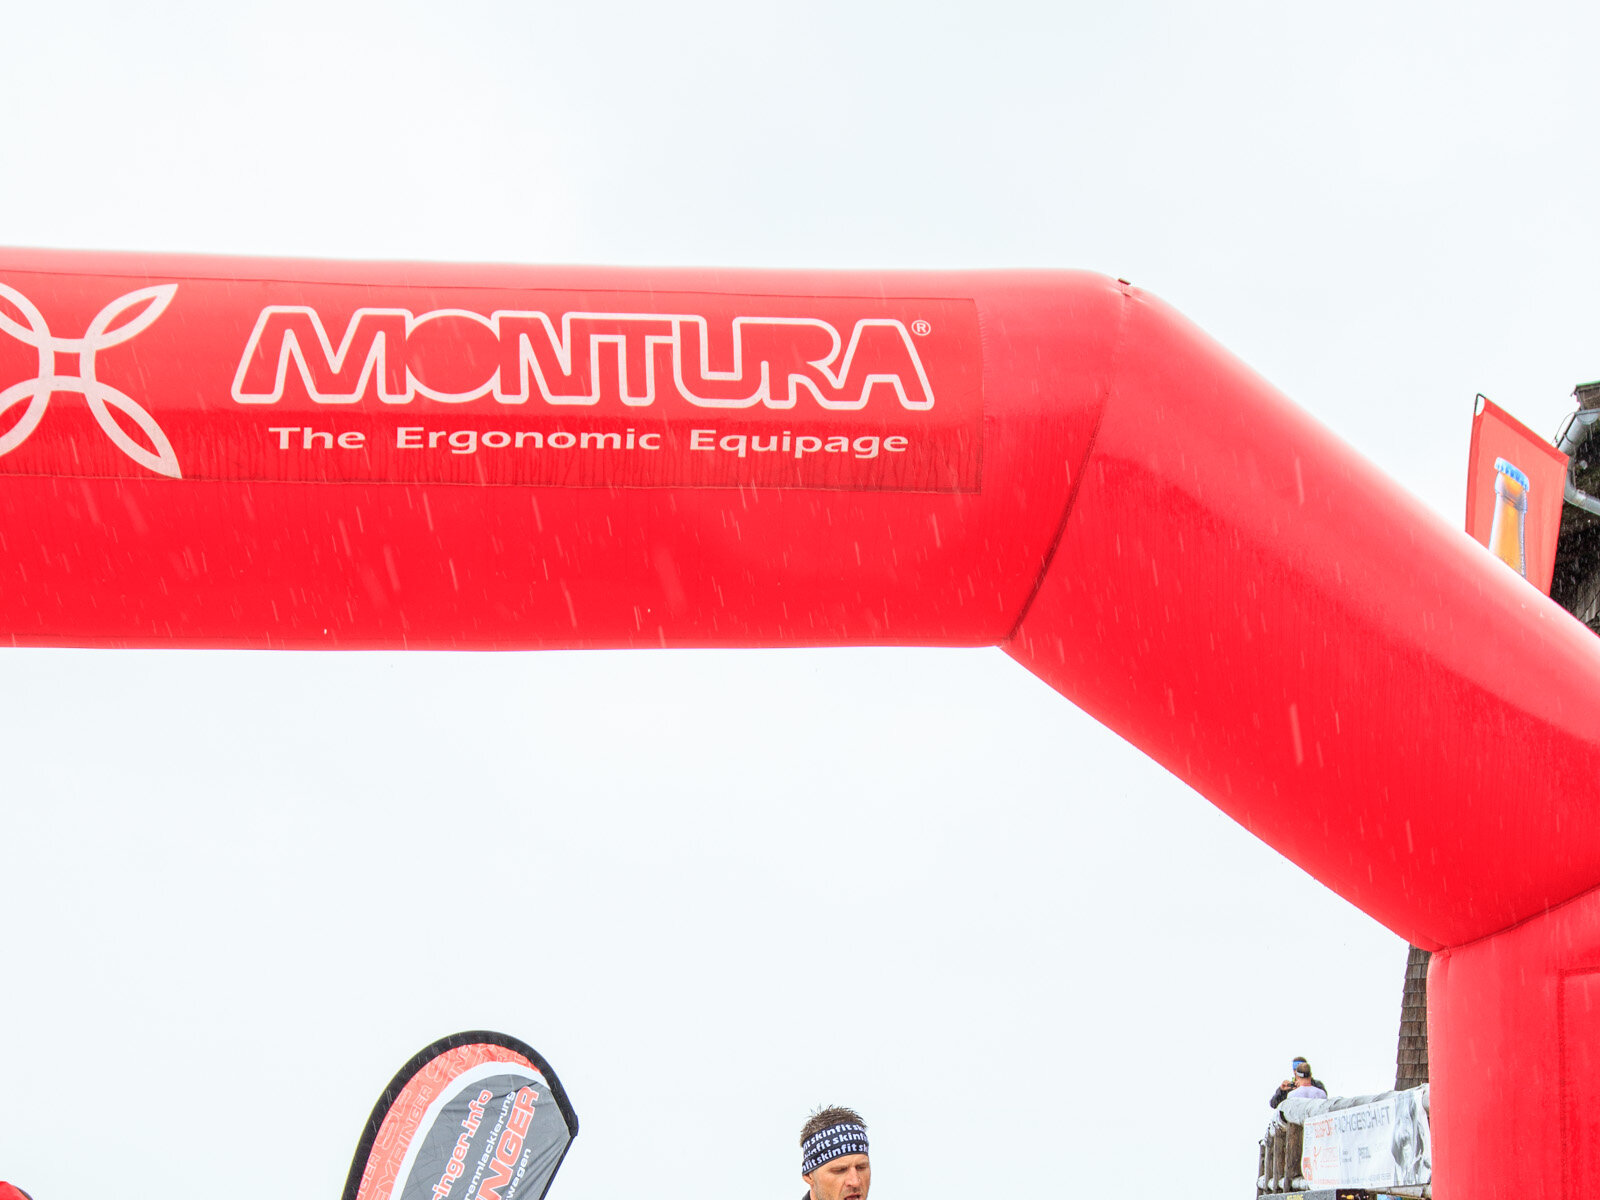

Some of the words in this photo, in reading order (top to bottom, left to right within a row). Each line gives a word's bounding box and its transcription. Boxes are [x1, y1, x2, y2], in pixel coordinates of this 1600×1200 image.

[268, 426, 366, 449] The
[396, 426, 661, 454] Ergonomic
[689, 429, 909, 459] Equipage
[811, 1124, 852, 1144] skinfit
[817, 1143, 857, 1164] skinfit
